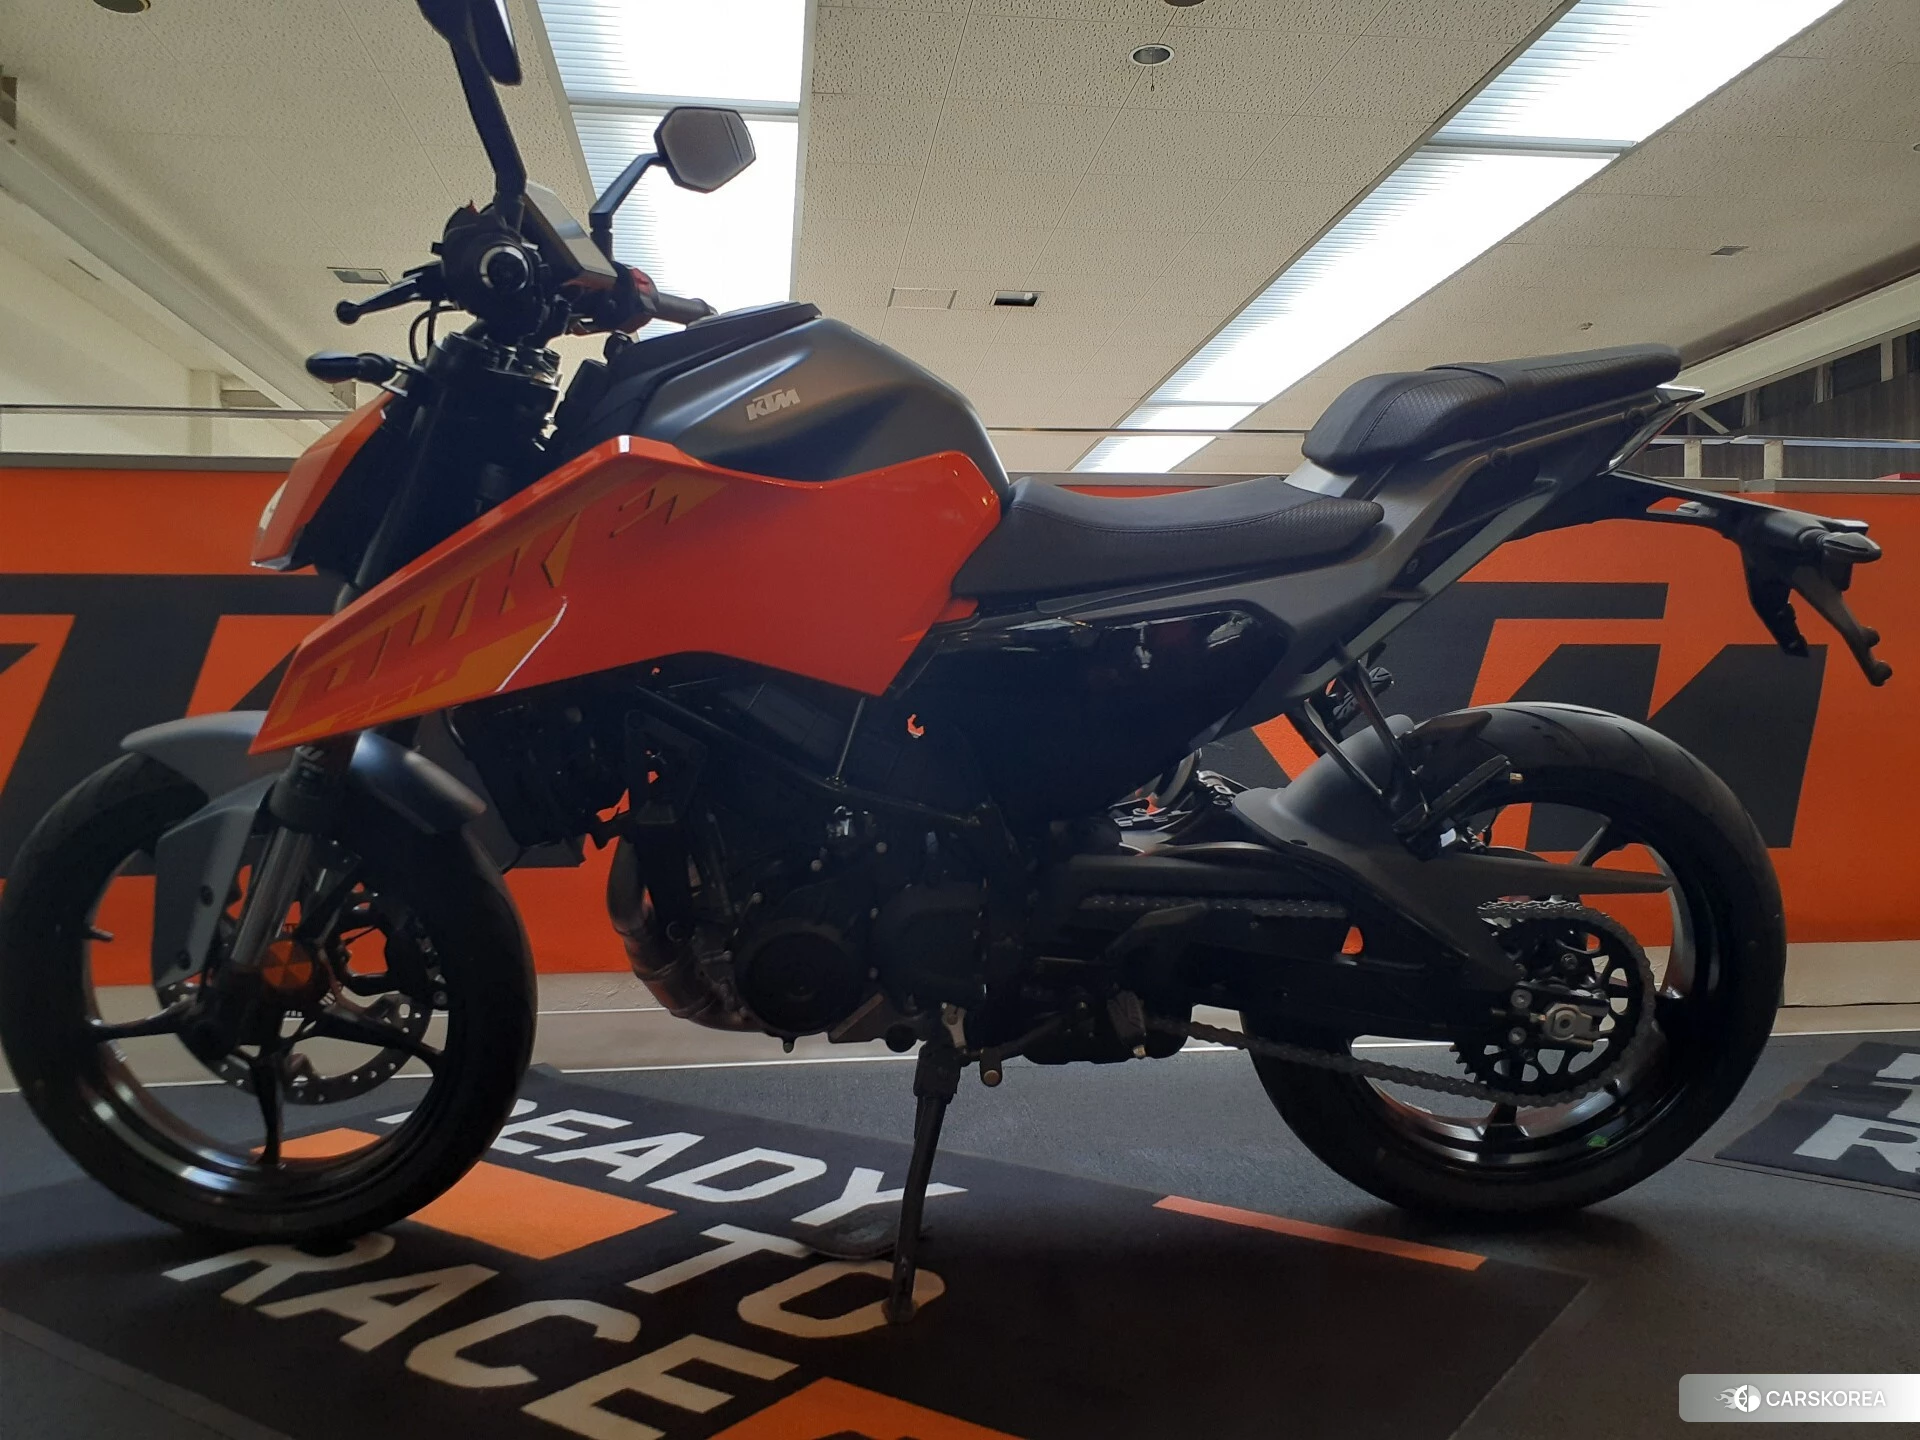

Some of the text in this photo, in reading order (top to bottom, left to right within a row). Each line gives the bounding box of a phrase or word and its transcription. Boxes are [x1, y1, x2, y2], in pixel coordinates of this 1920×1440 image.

[746, 389, 800, 420] KTM
[161, 1231, 800, 1440] RACE
[624, 1222, 946, 1339] TO
